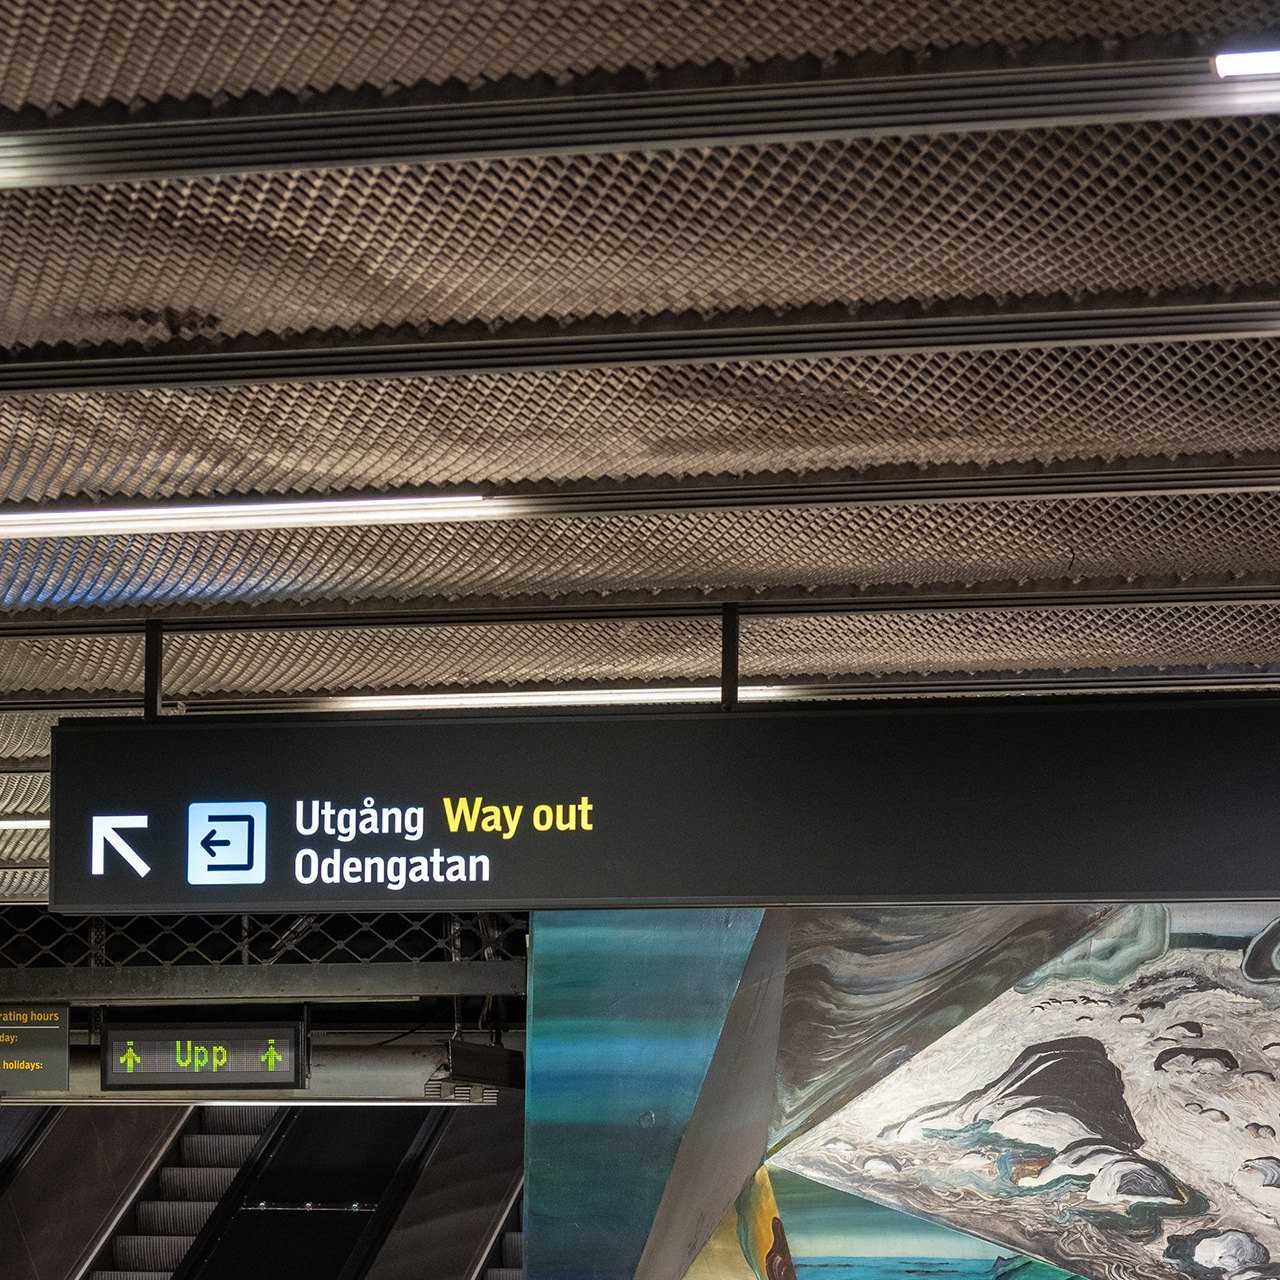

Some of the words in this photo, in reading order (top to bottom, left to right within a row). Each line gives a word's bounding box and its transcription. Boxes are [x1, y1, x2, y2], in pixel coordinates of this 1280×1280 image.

[295, 796, 424, 842] Utgång
[442, 796, 524, 840] Way
[532, 796, 594, 832] out
[294, 847, 490, 891] Odengatan
[30, 1011, 59, 1021] hours
[3, 1060, 43, 1071] holidays:
[175, 1040, 228, 1073] Upp
